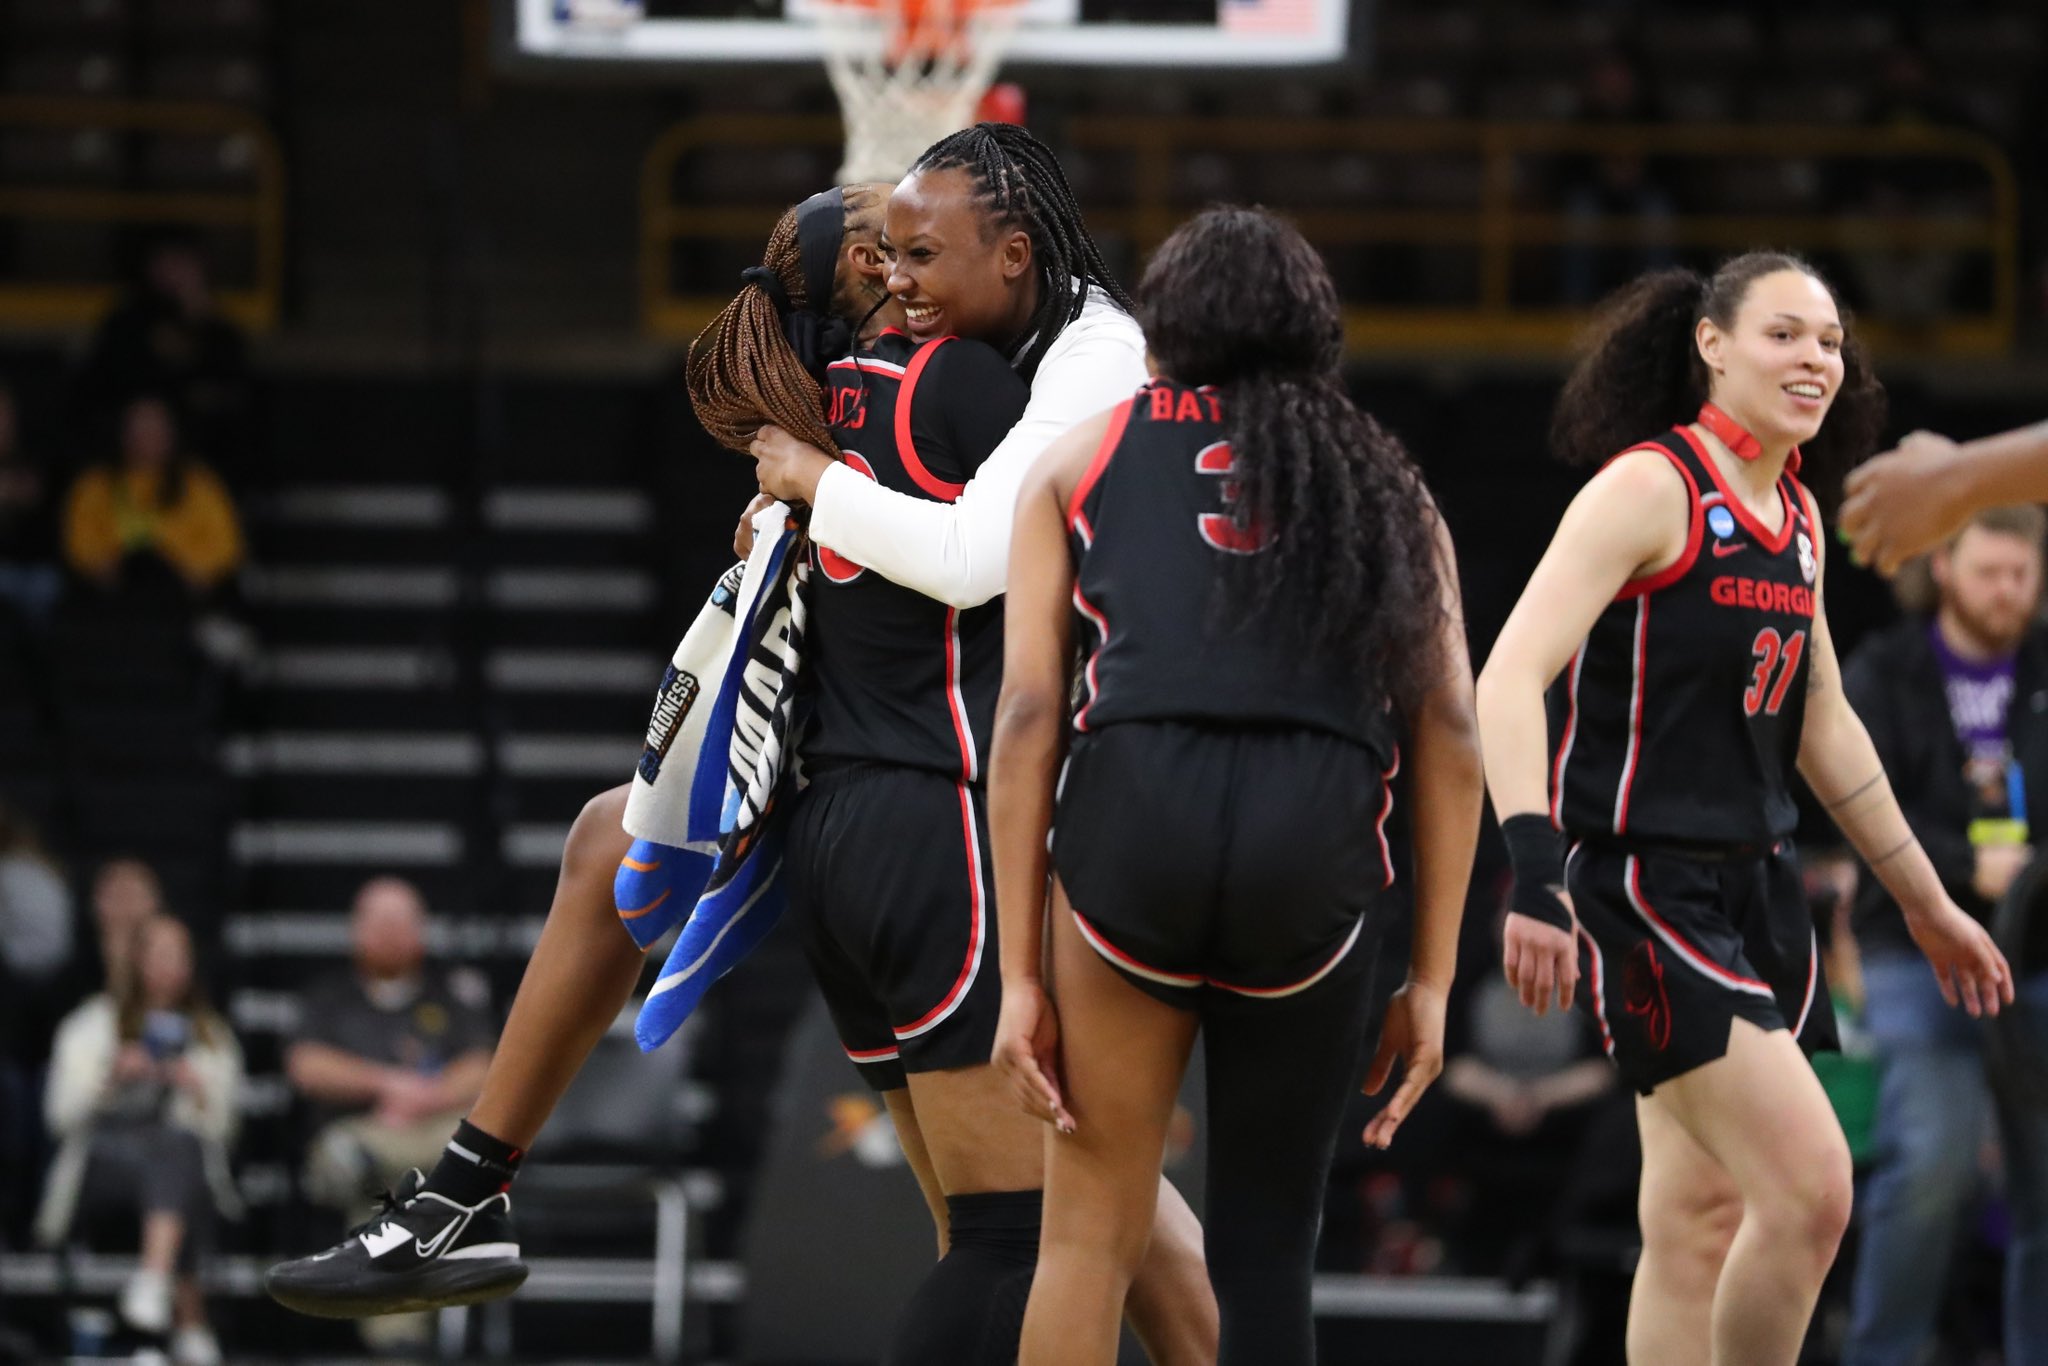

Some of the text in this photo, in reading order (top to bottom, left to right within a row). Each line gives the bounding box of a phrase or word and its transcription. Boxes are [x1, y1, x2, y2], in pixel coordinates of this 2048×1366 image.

[1195, 440, 1281, 555] 3
[1710, 575, 1816, 619] GEORGI
[646, 672, 695, 751] MADNESS
[1743, 626, 1806, 717] 31
